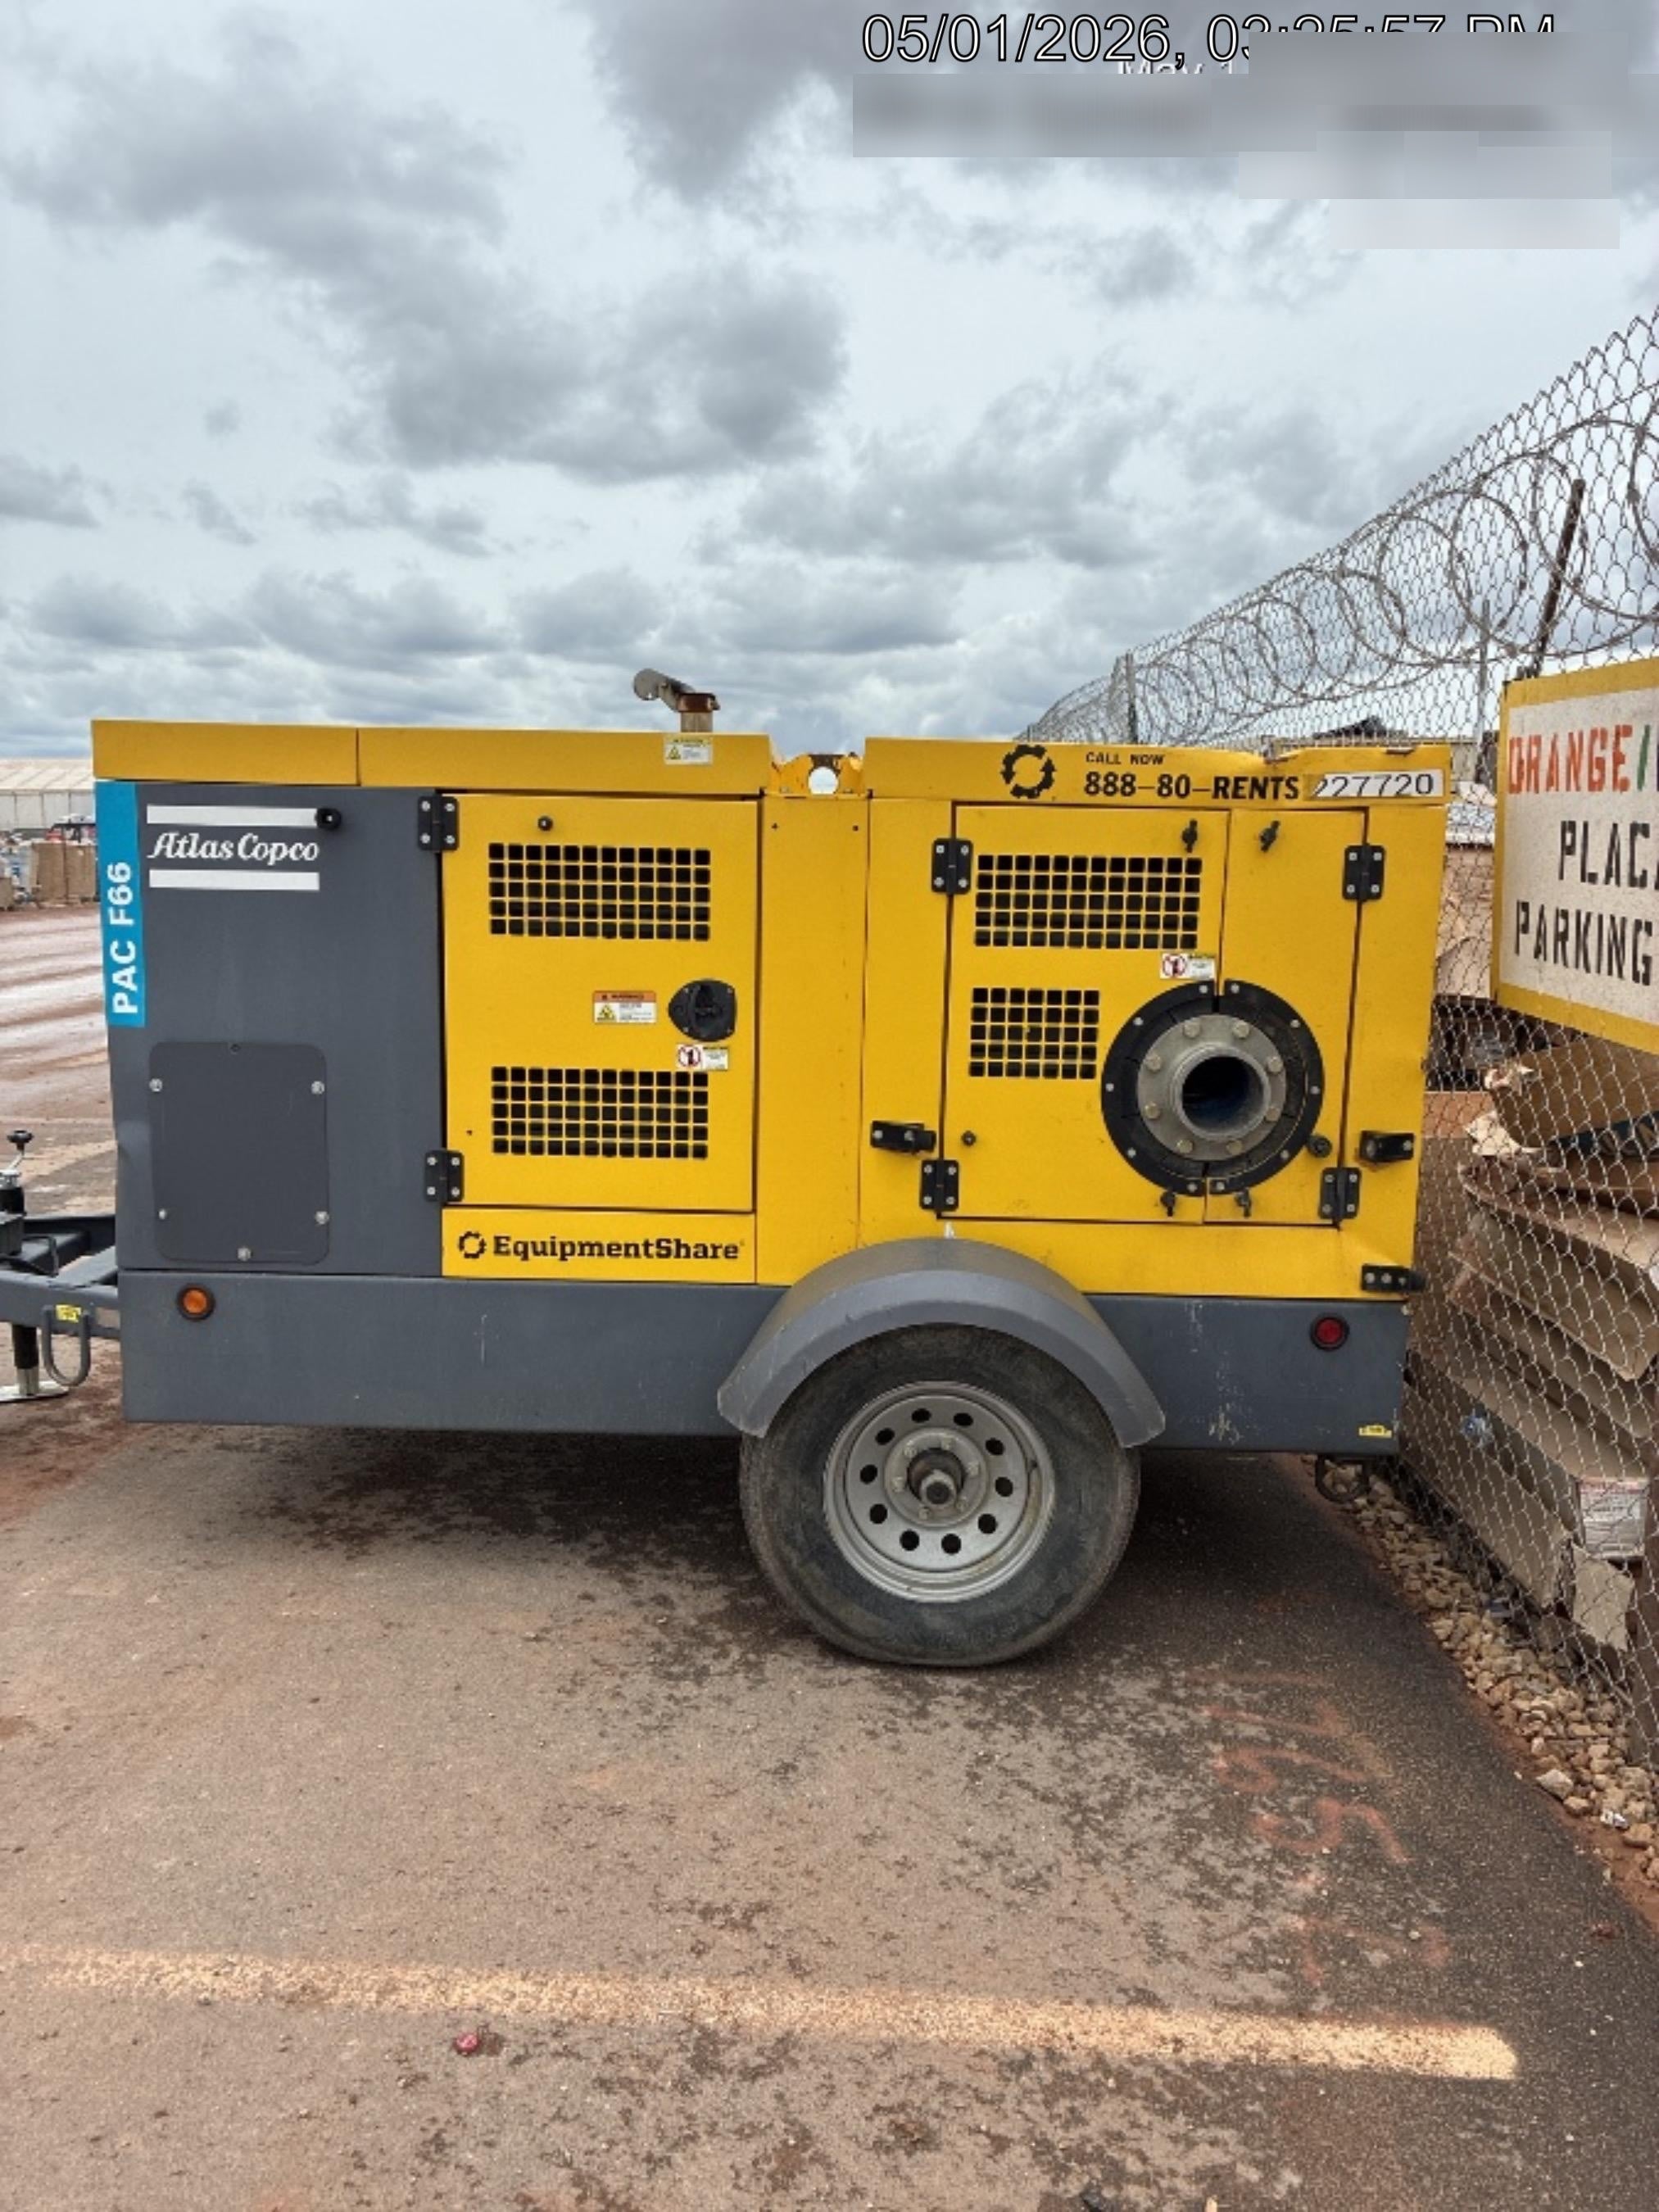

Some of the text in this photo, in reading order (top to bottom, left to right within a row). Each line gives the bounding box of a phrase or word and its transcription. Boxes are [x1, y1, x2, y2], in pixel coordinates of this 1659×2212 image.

[1086, 751, 1166, 766] CALL NOW
[1509, 724, 1659, 795] ORANGE/
[147, 830, 320, 866] Atlas Copco
[1557, 819, 1659, 891] PLAC
[107, 861, 139, 1014] PAC F66
[1515, 900, 1653, 986] PARKING
[493, 1235, 740, 1262] EquipmentShare
